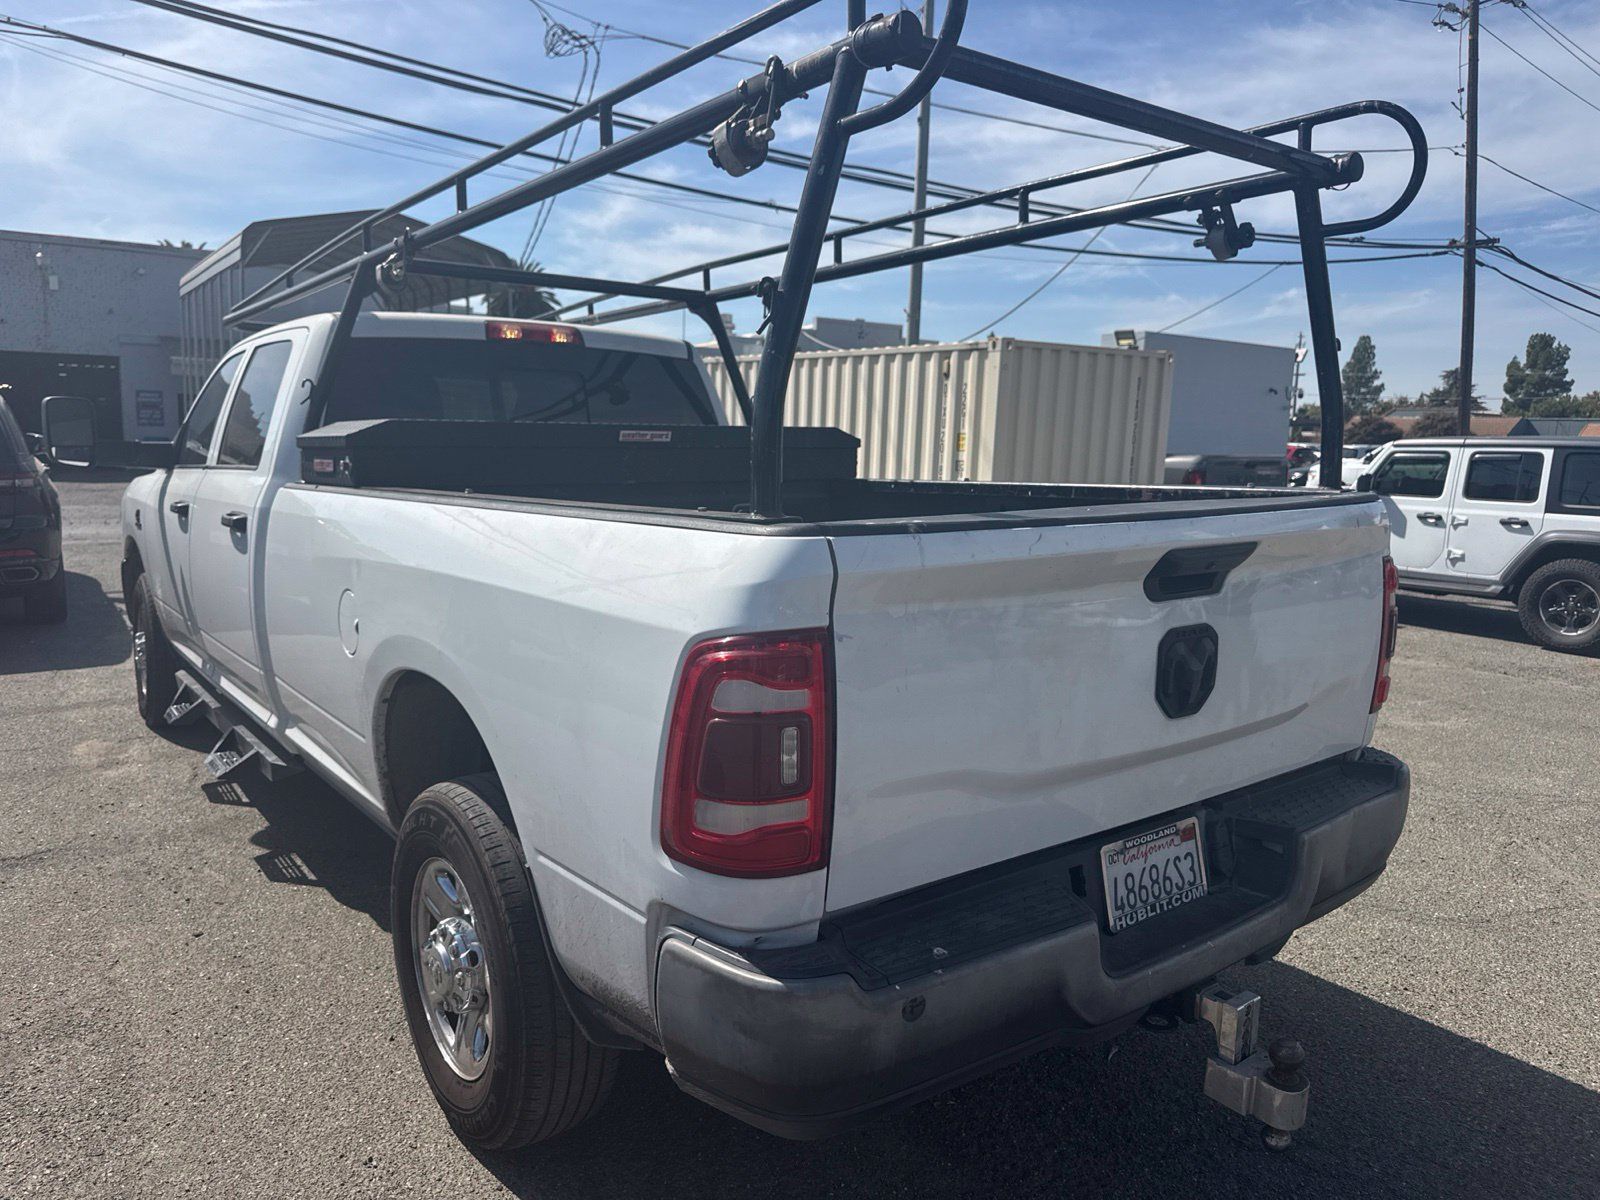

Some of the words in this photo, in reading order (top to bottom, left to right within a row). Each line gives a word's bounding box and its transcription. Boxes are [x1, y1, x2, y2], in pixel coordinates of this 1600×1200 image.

[1122, 838, 1181, 866] California
[1125, 826, 1177, 848] WOODLAND
[1114, 852, 1197, 913] 48686S3
[1116, 886, 1204, 930] HOBLIT.COM
